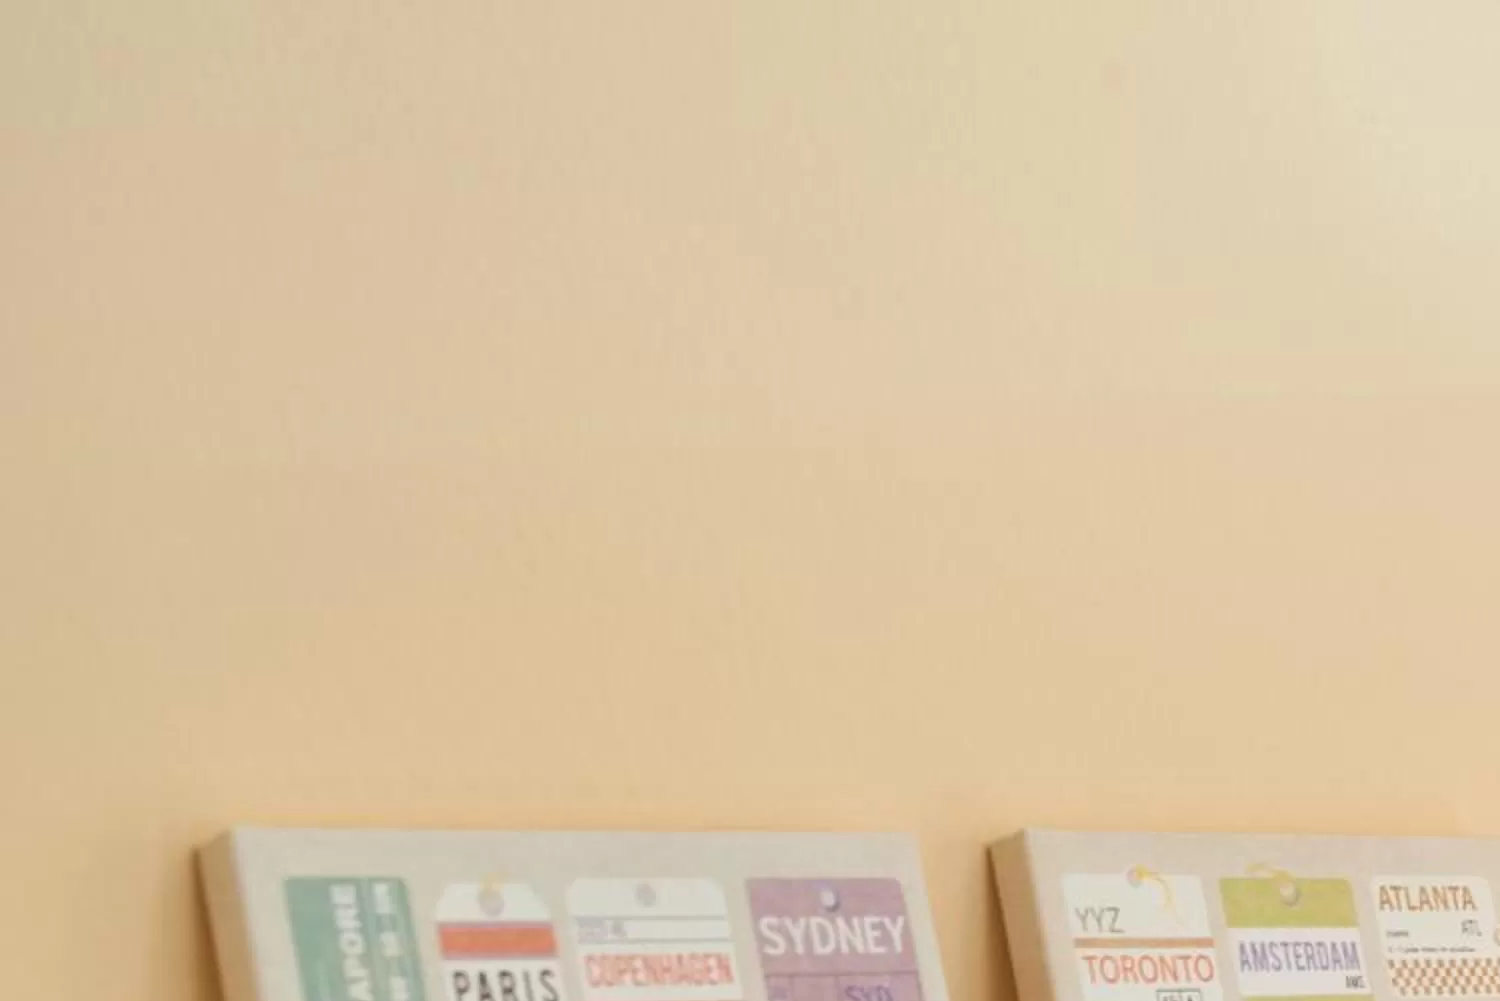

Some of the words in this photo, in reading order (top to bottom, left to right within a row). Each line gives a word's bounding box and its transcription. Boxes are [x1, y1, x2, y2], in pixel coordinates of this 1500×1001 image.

[1379, 886, 1478, 912] ATLANTA
[759, 915, 906, 956] SYDNEY
[1074, 906, 1125, 934] YYZ
[584, 953, 735, 988] COPENHAGEN
[1082, 954, 1215, 985] TORONTO
[1238, 941, 1361, 973] AMSTERDAM
